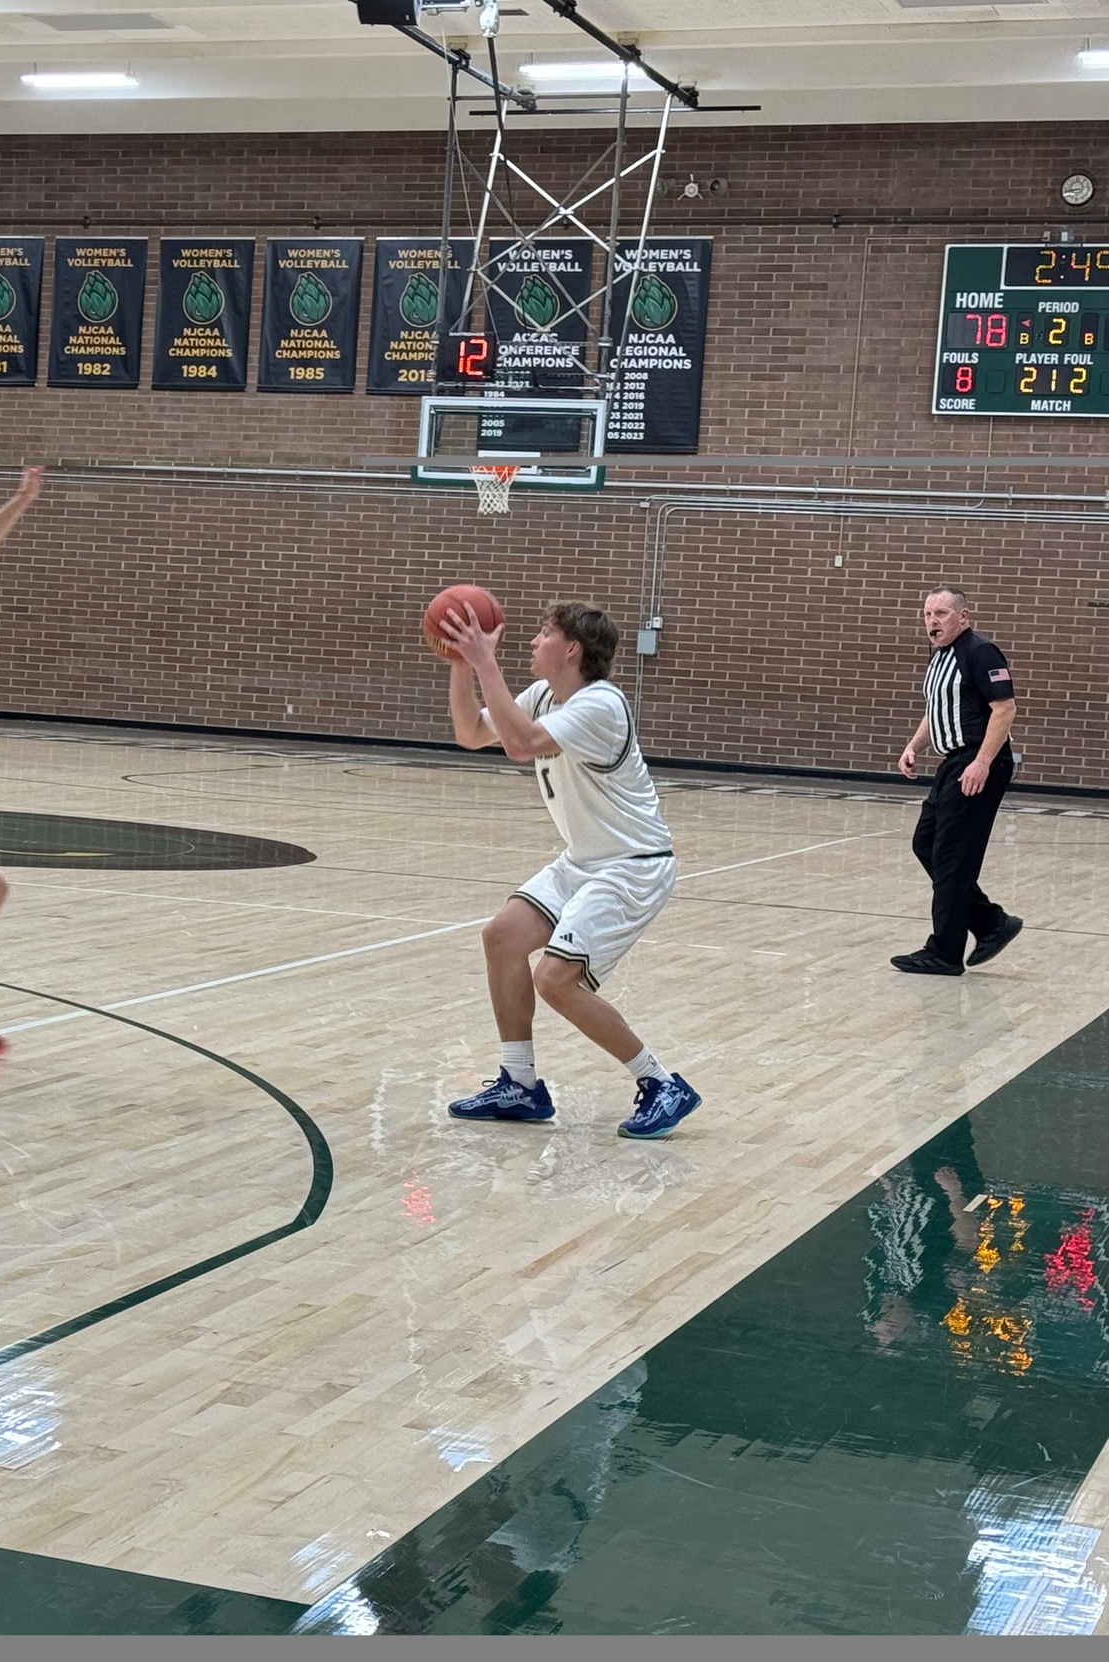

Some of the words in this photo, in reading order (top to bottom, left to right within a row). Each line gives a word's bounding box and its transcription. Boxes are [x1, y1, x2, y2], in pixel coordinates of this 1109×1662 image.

[76, 248, 126, 257] WOMEN'S
[181, 249, 233, 258] WOMEN'S
[288, 249, 340, 258] WOMEN'S
[398, 250, 452, 258] WOMENS
[67, 258, 134, 268] VOLLEYBALL
[172, 259, 240, 268] VOLLEYBALL
[278, 259, 348, 269] VOLLEYBALL
[389, 260, 461, 269] VOLLEYBLL
[956, 292, 1004, 309] HOME
[1038, 302, 1079, 313] PERIOD
[78, 326, 114, 335] NJCAA
[183, 328, 220, 336] NJCAA
[290, 329, 328, 338] NJCAA
[966, 313, 1007, 347] 78
[1048, 318, 1066, 344] 2
[69, 336, 122, 345] NATIONAL
[174, 338, 228, 347] NATIONAL
[628, 333, 676, 344] NJCAA
[1020, 333, 1029, 344] B
[1084, 333, 1094, 345] B
[280, 340, 336, 349] NATIONAL
[64, 346, 126, 356] CHAMPIONS
[168, 348, 233, 358] CHAMPIONS
[275, 350, 341, 360] CHAMPIONS
[498, 345, 580, 355] ONFERENCE
[458, 338, 488, 375] 12
[943, 352, 979, 363] FOULS
[1015, 353, 1059, 364] PLAYER
[1064, 354, 1094, 365] FOUL
[77, 363, 112, 375] 1982
[182, 365, 218, 378] 1984
[288, 367, 325, 380] 1985
[956, 366, 972, 393] 8
[940, 399, 976, 410] SCORE
[1030, 400, 1071, 411] MATCH
